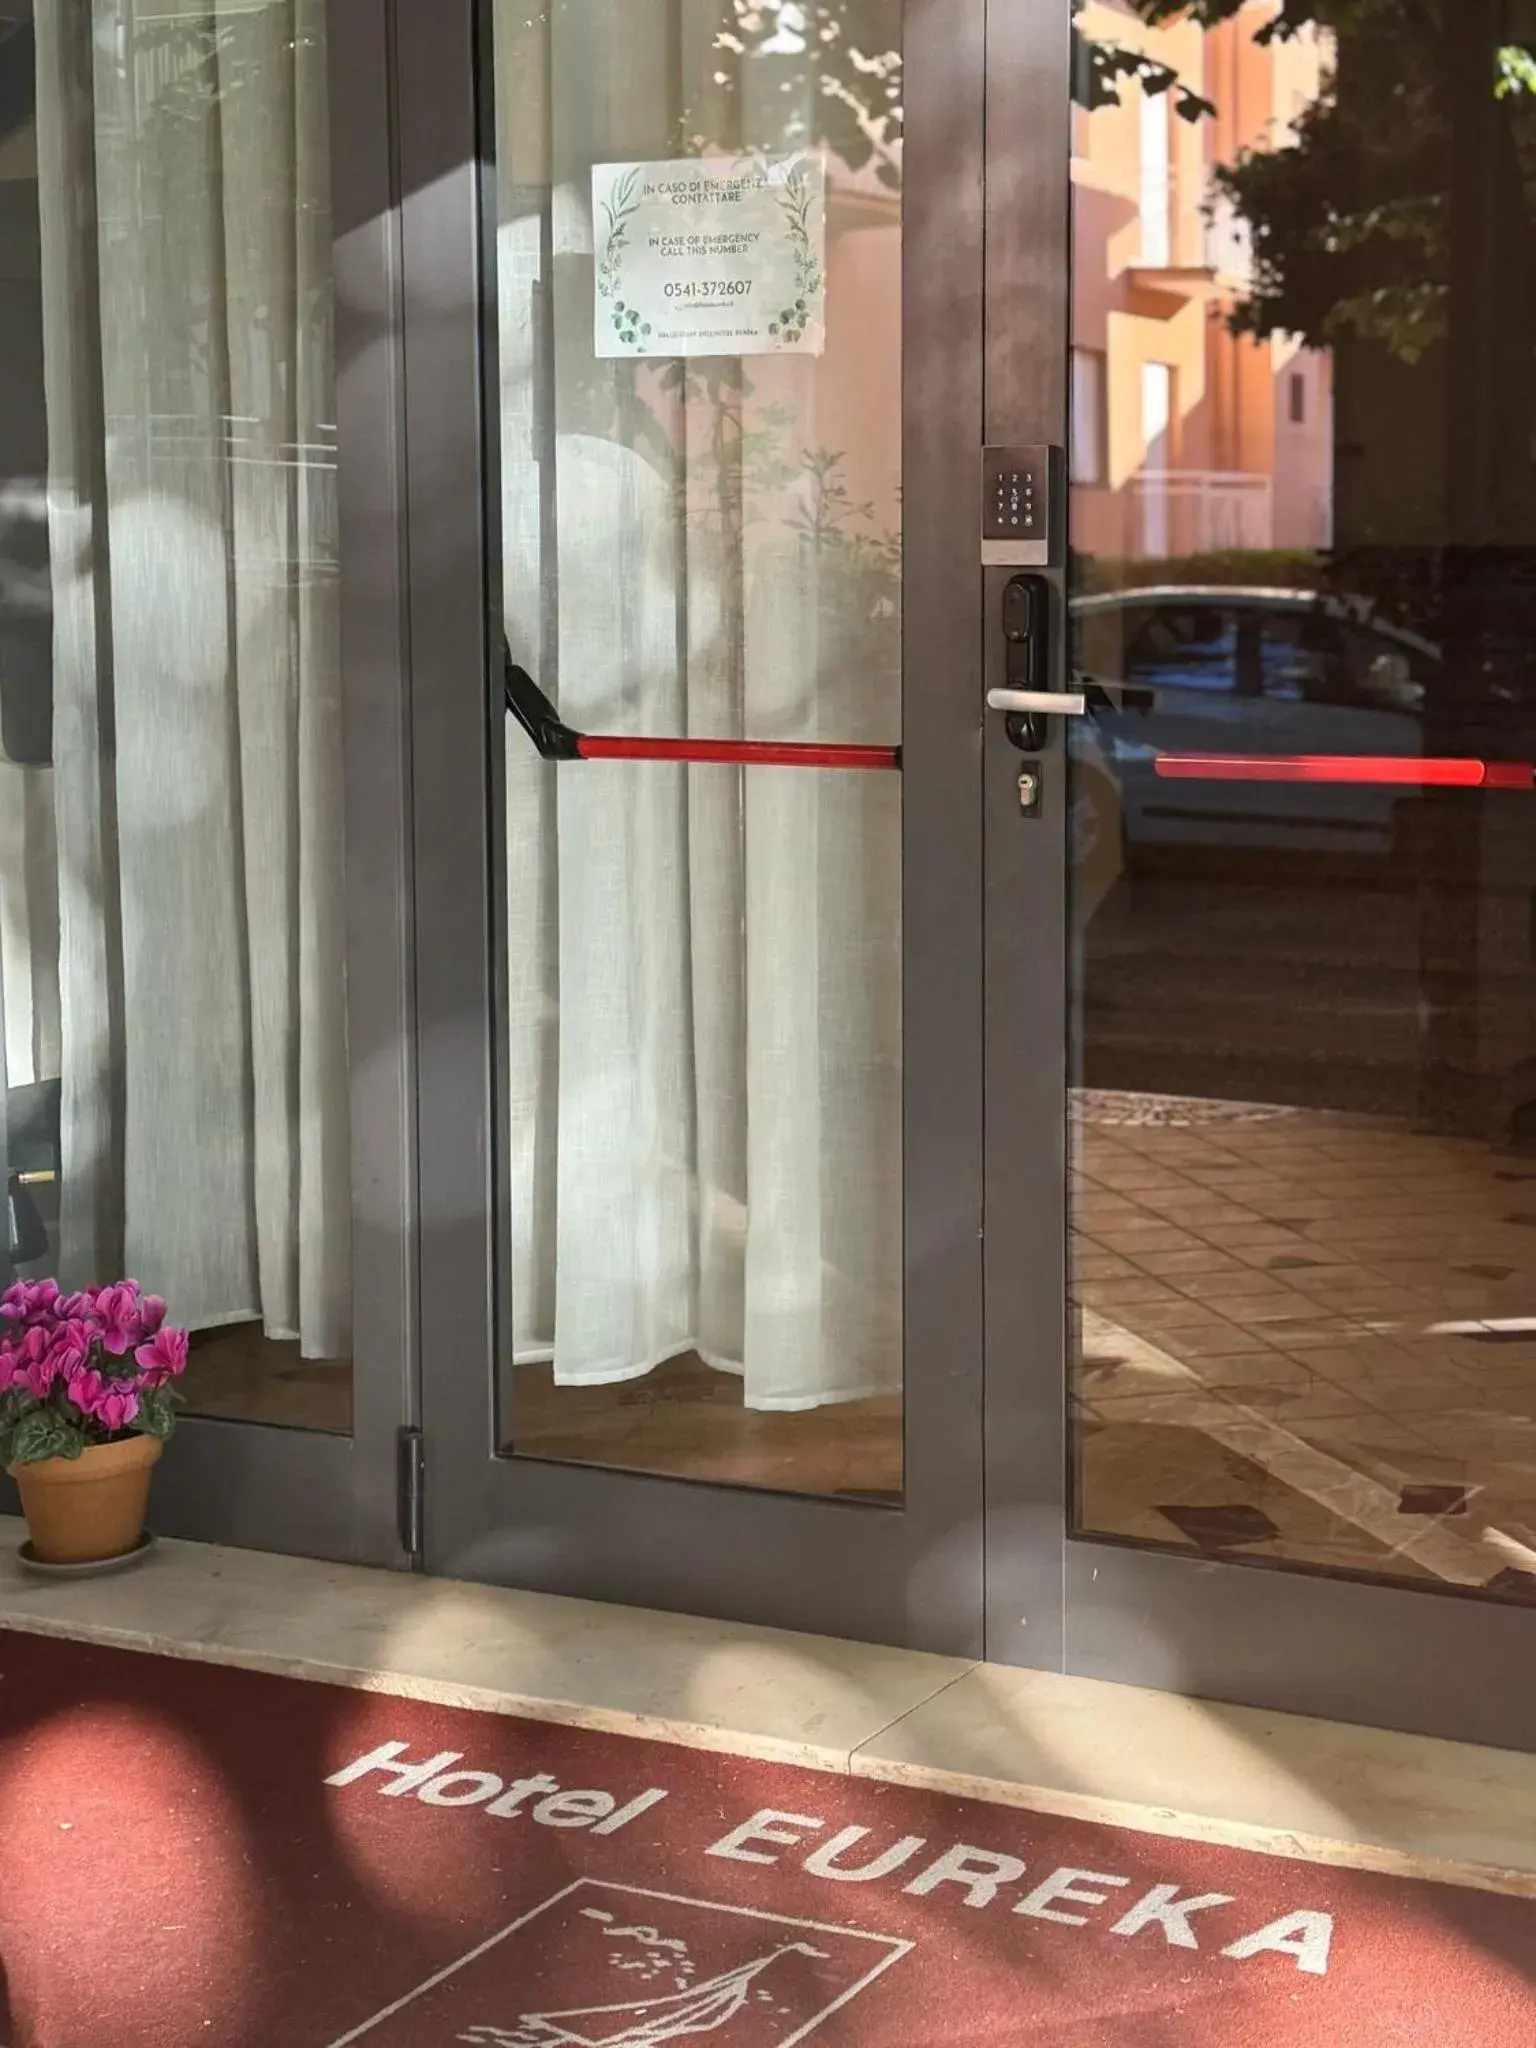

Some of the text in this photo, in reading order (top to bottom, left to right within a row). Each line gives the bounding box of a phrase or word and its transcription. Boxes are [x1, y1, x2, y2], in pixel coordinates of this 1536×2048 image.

[643, 184, 655, 194] IN
[658, 182, 687, 193] CASO
[689, 181, 701, 192] DI
[672, 191, 741, 204] CONTATTARE
[649, 232, 760, 246] IN CASE OF EMERGENCY
[660, 244, 749, 256] CALL THIS NUMBER
[324, 1740, 1334, 1974] Hotel EUREKA
